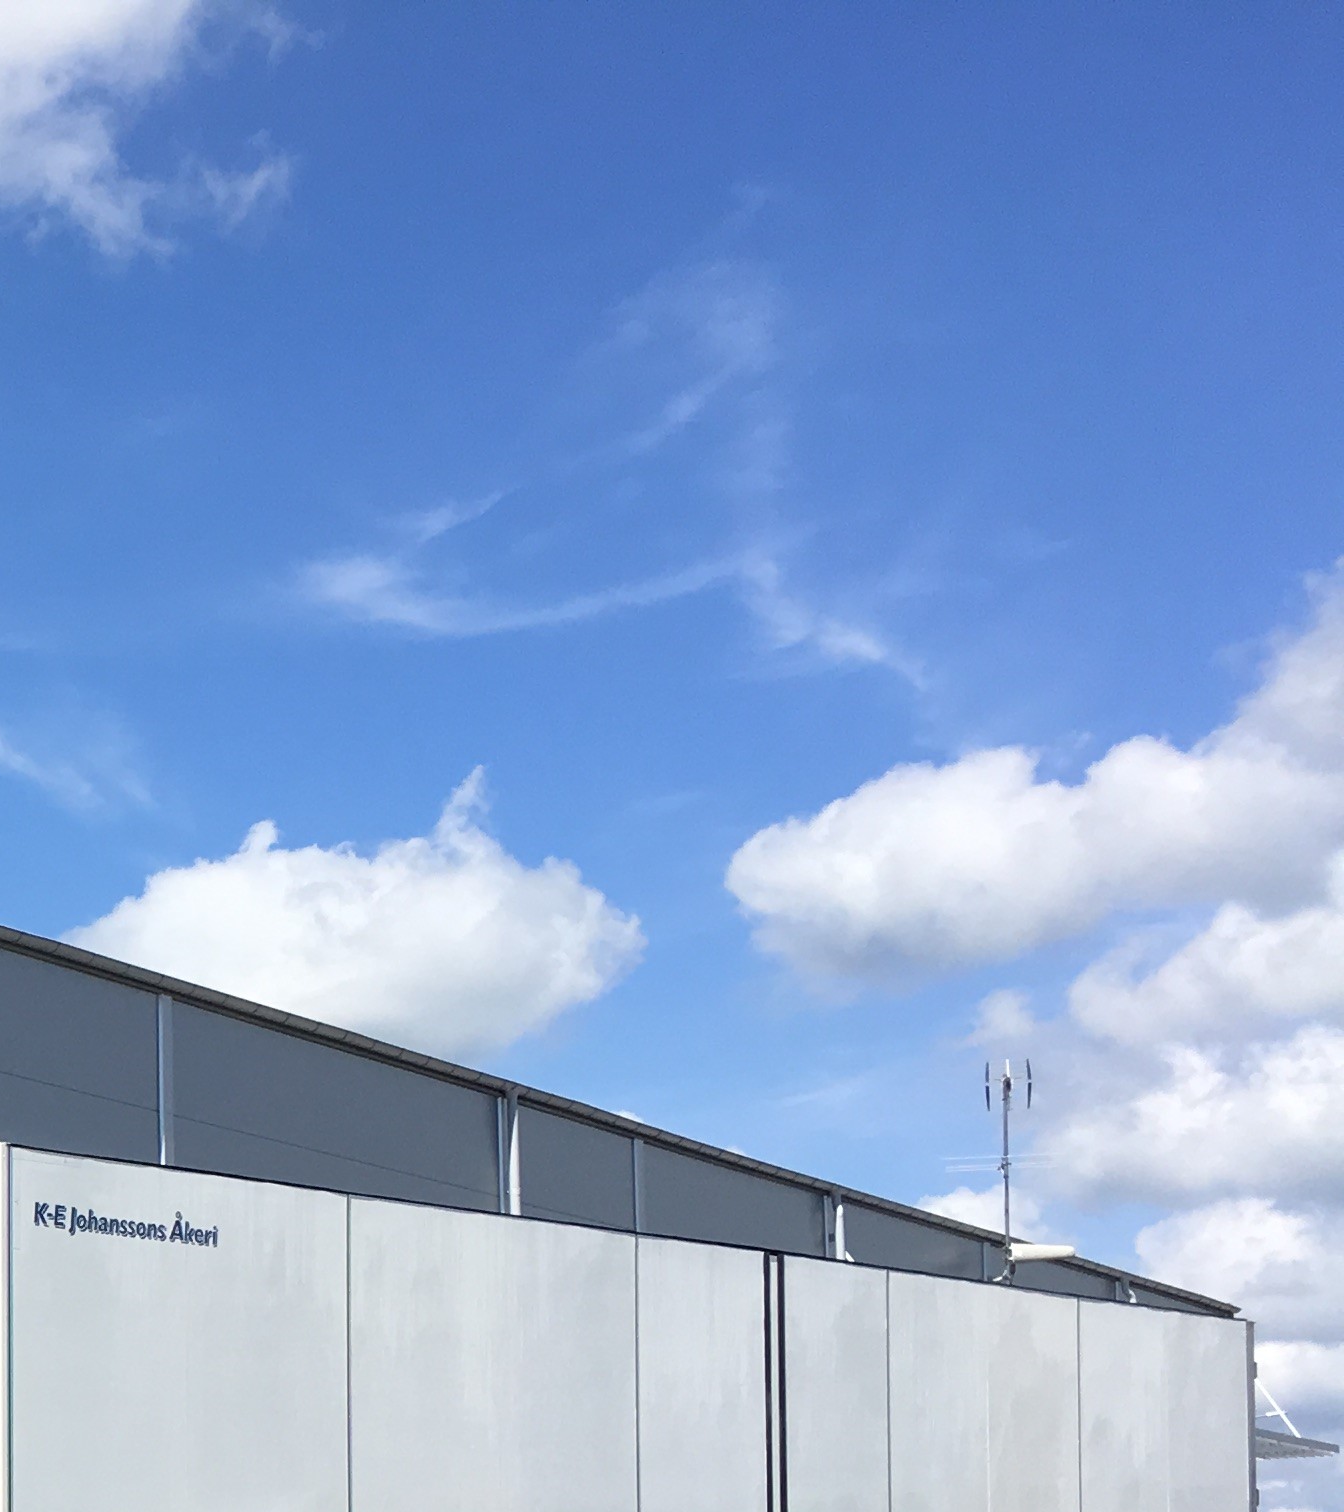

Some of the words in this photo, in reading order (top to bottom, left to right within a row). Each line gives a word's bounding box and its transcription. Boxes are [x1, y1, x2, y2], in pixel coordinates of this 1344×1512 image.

[34, 1202, 66, 1229] K-E
[69, 1207, 166, 1242] Johanssons
[170, 1211, 218, 1248] Åkeri
